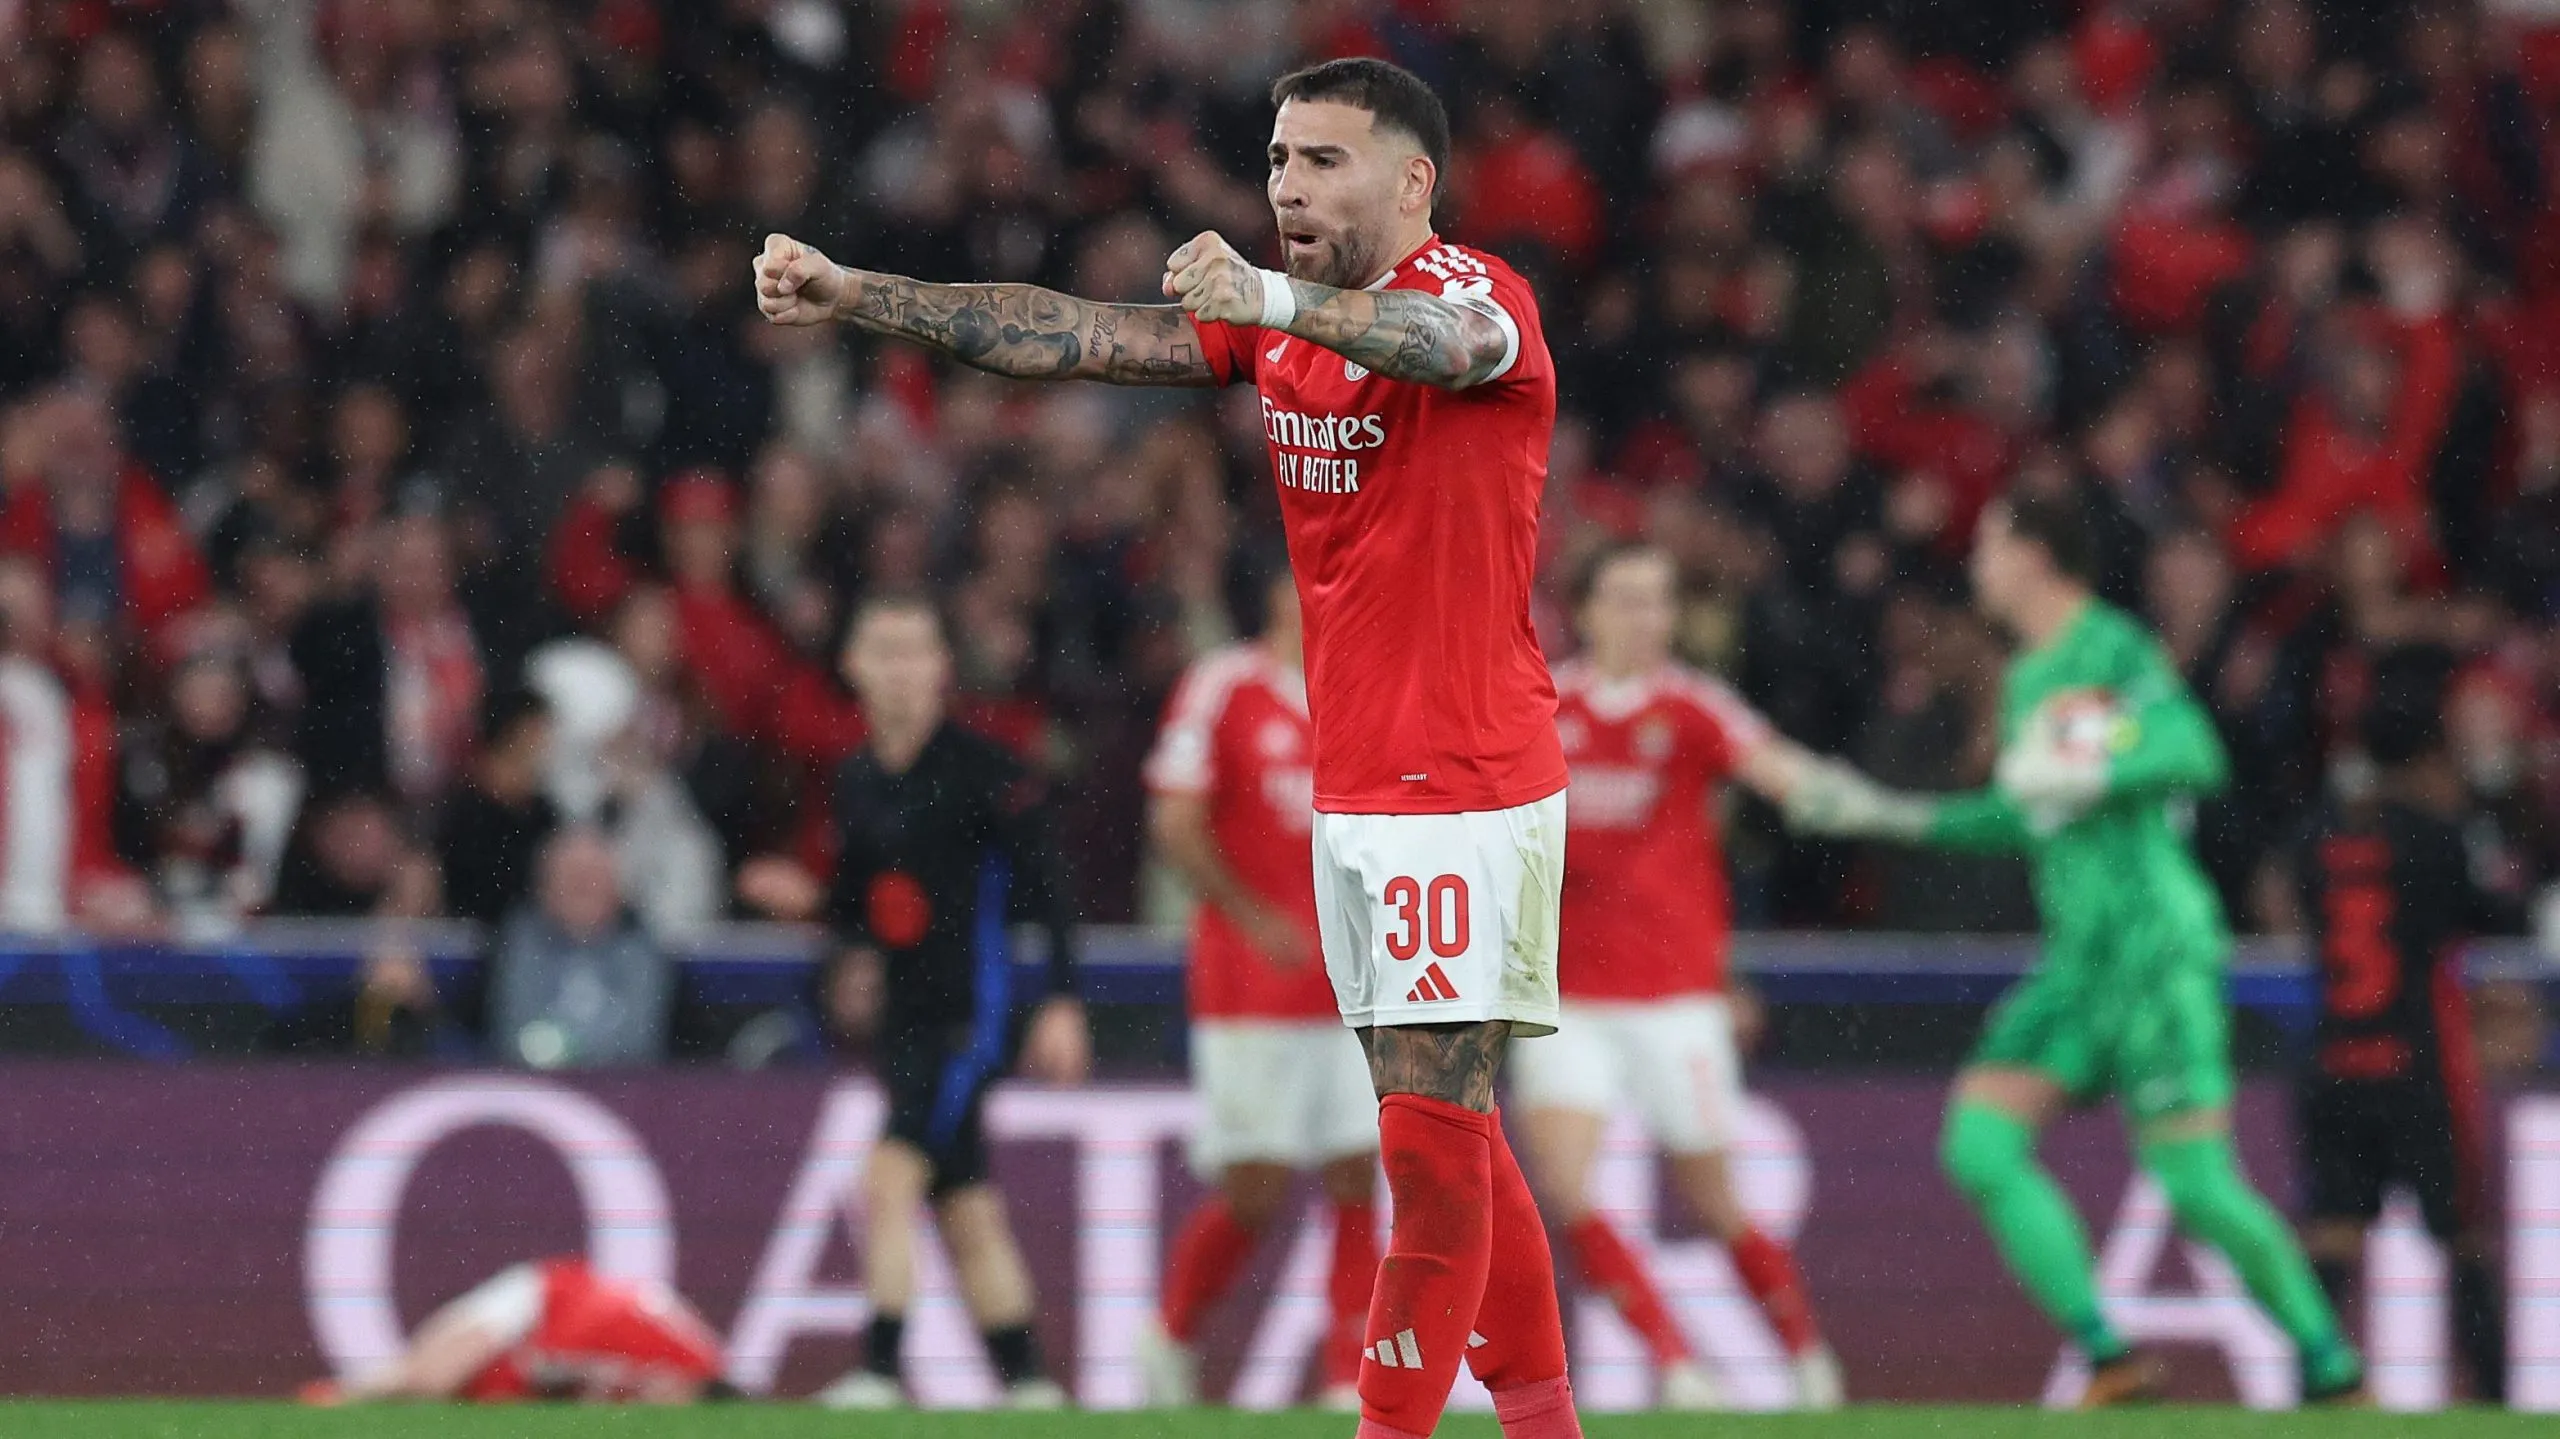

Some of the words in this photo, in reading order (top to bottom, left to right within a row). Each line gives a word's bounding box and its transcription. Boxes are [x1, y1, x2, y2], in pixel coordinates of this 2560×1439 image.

[1261, 395, 1385, 452] Emirates
[1278, 451, 1298, 488] FLY
[1302, 455, 1359, 494] BETTER
[1383, 873, 1470, 961] 30
